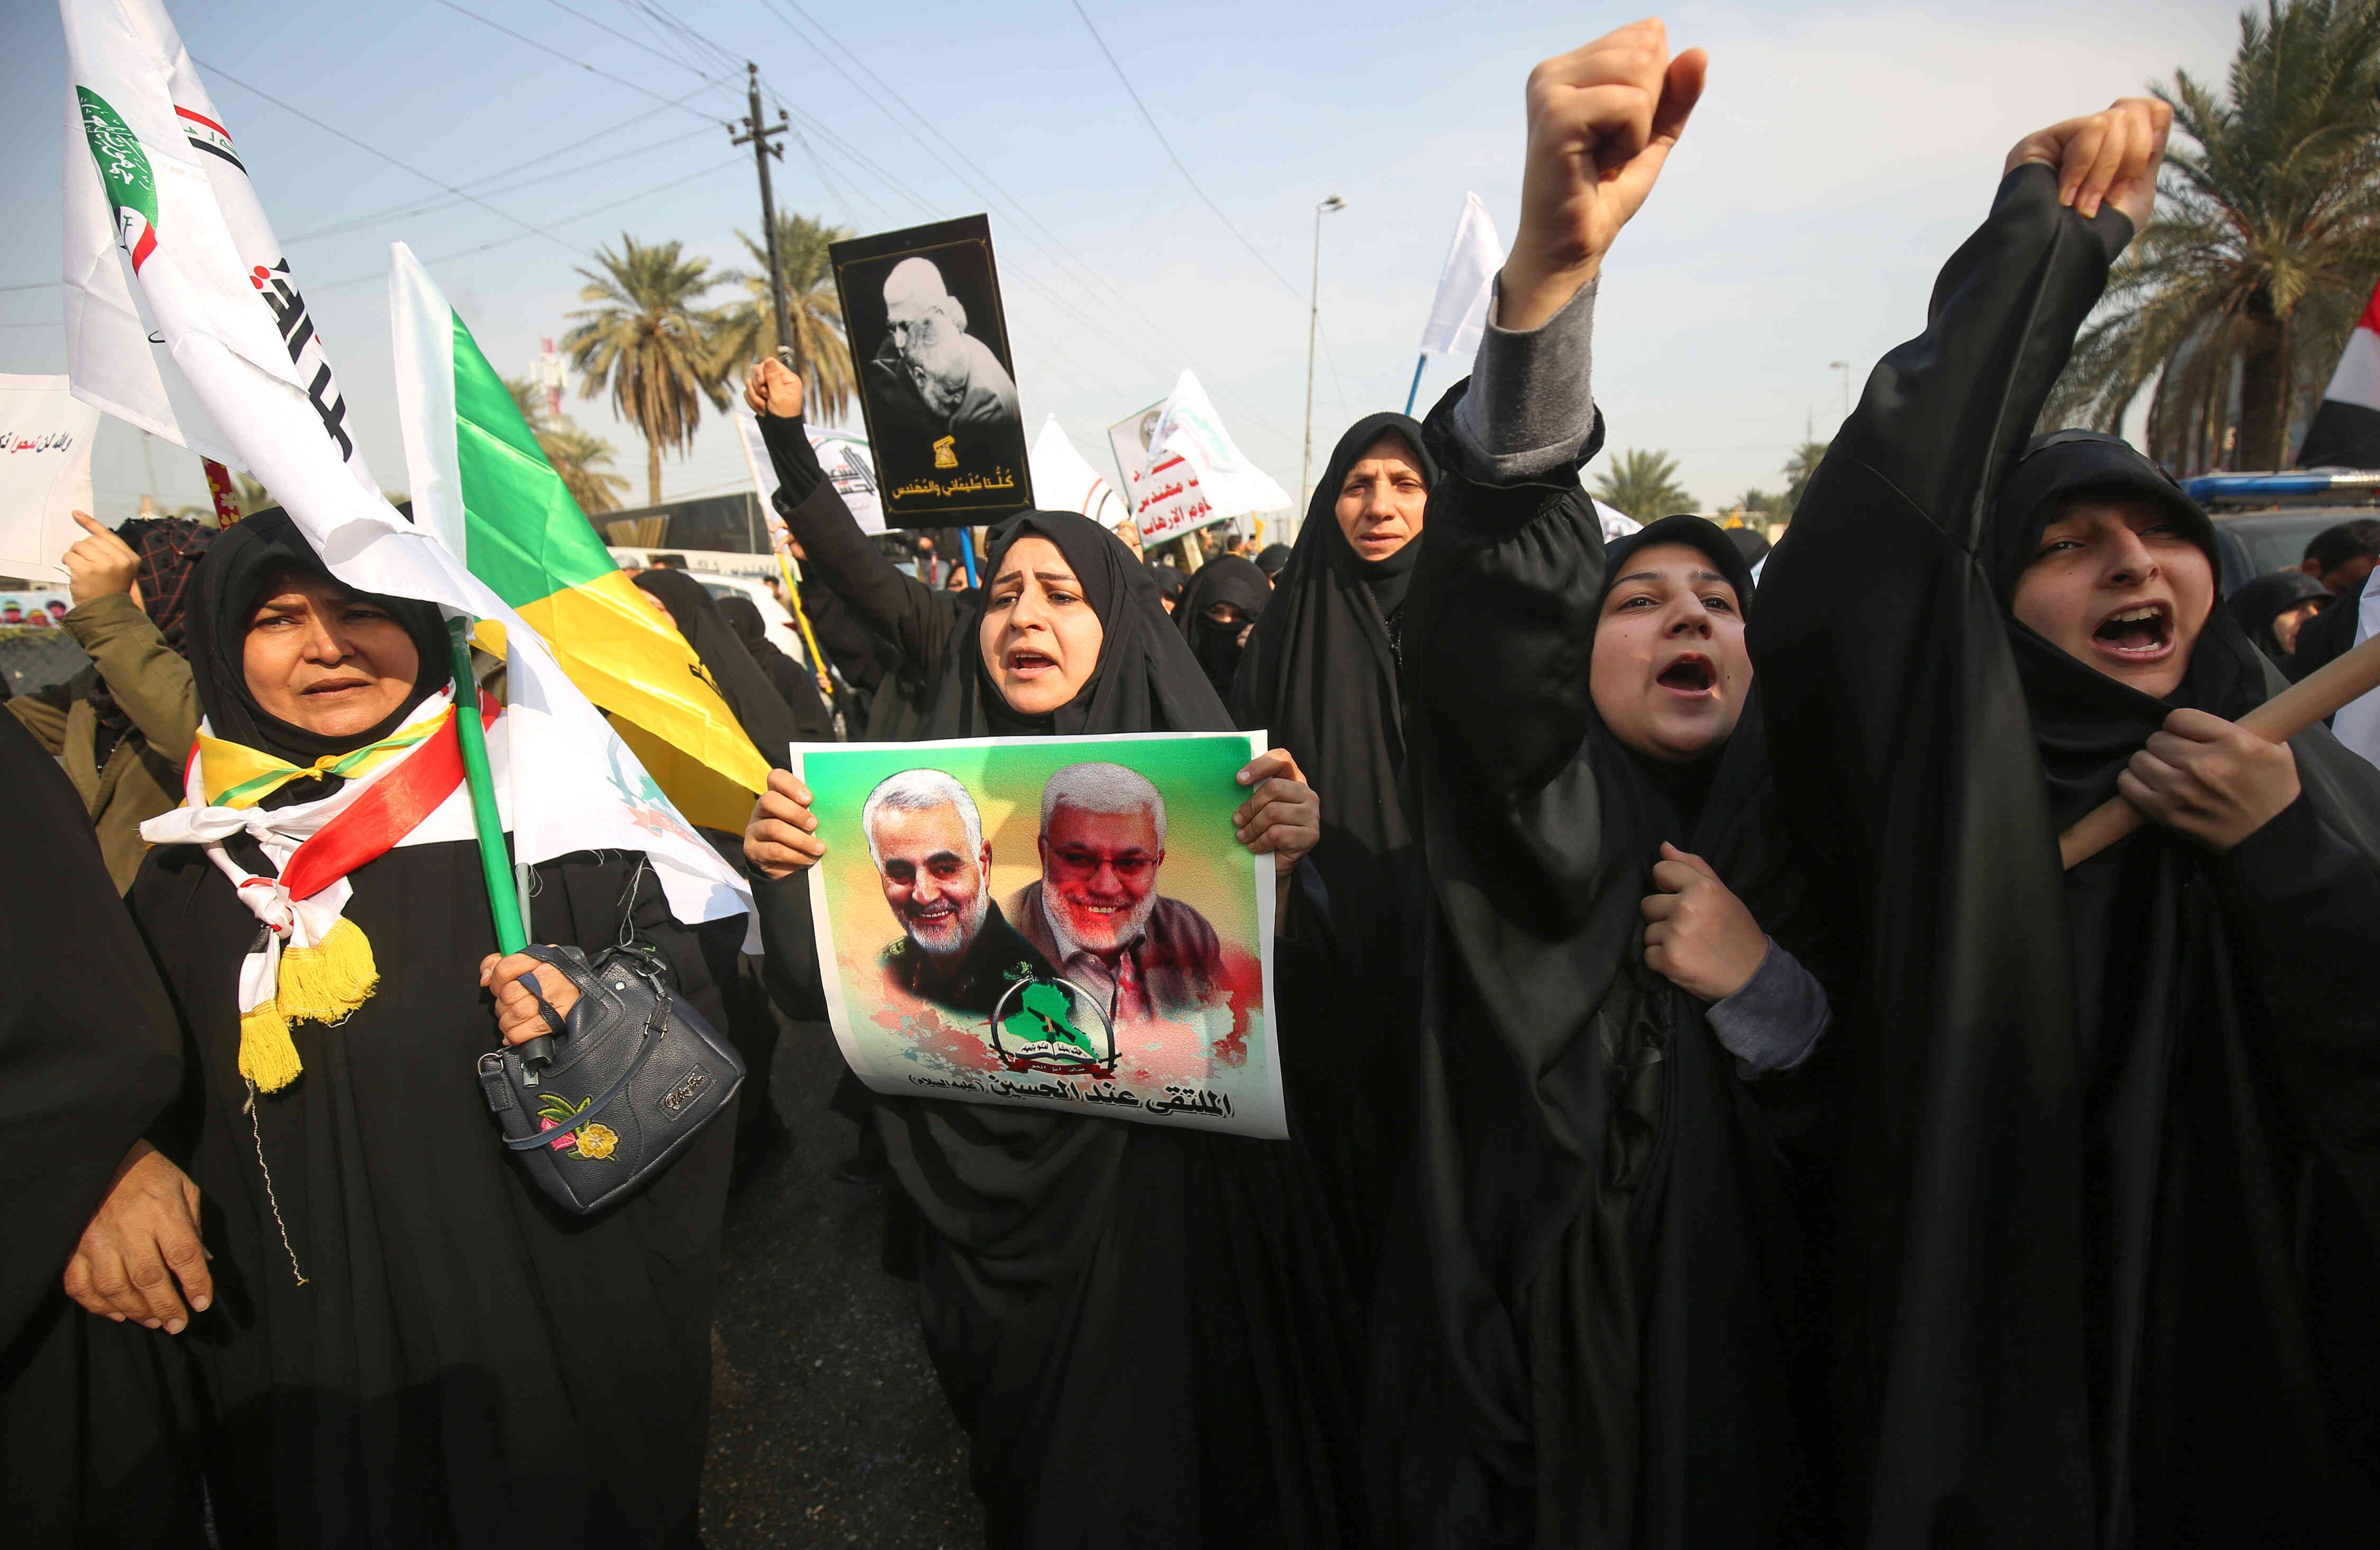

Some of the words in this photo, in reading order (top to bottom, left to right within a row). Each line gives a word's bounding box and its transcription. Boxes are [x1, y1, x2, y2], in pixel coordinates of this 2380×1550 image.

[987, 1074, 1083, 1101] الحسين
[1085, 1081, 1142, 1108] عند
[1146, 1086, 1235, 1118] الملتقى
